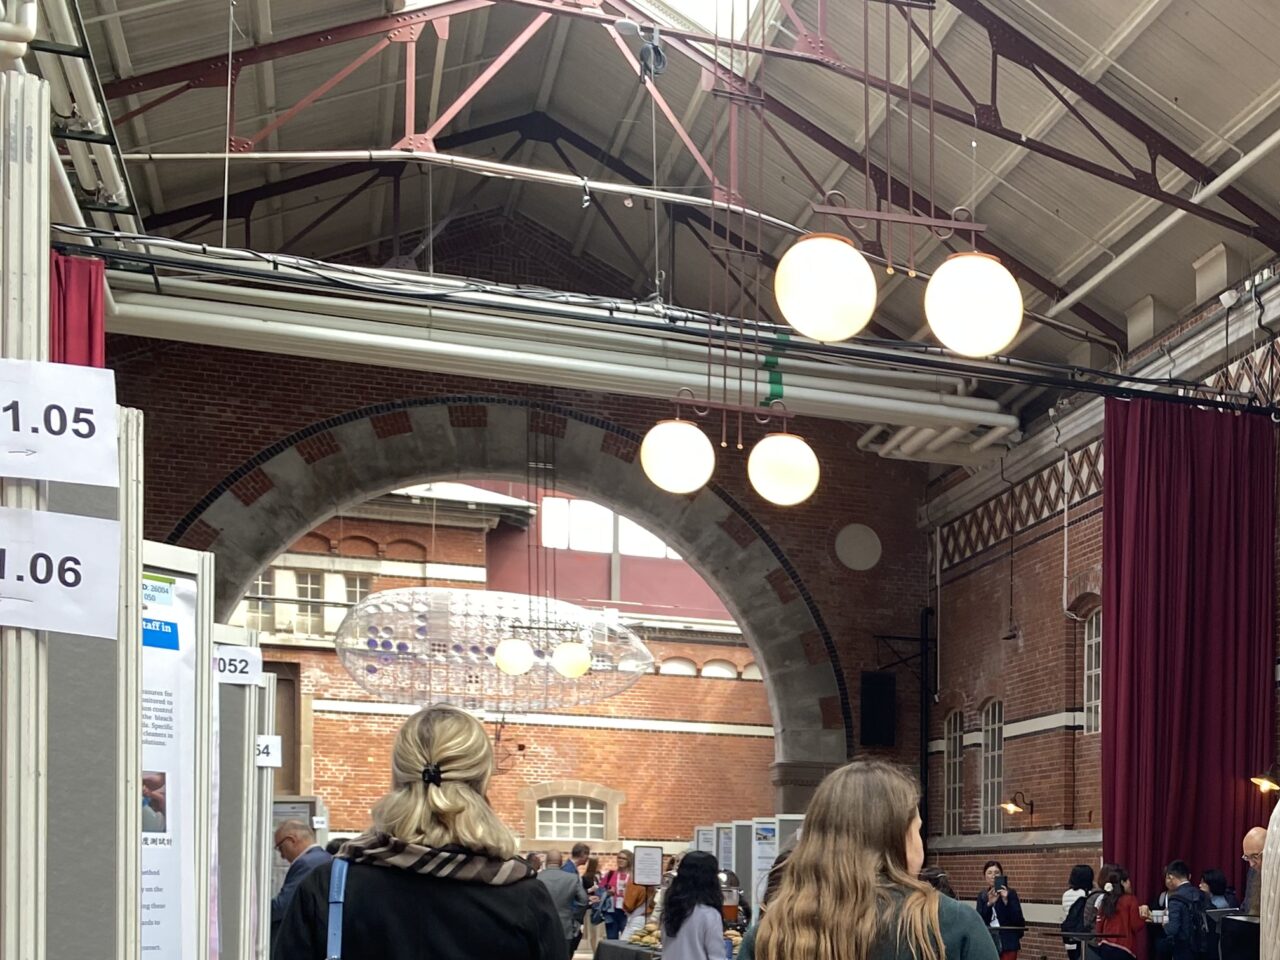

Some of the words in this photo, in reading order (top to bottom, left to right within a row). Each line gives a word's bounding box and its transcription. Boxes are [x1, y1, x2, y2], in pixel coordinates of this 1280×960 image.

[2, 400, 96, 439] 1.05
[161, 622, 171, 632] in
[217, 657, 249, 674] 052
